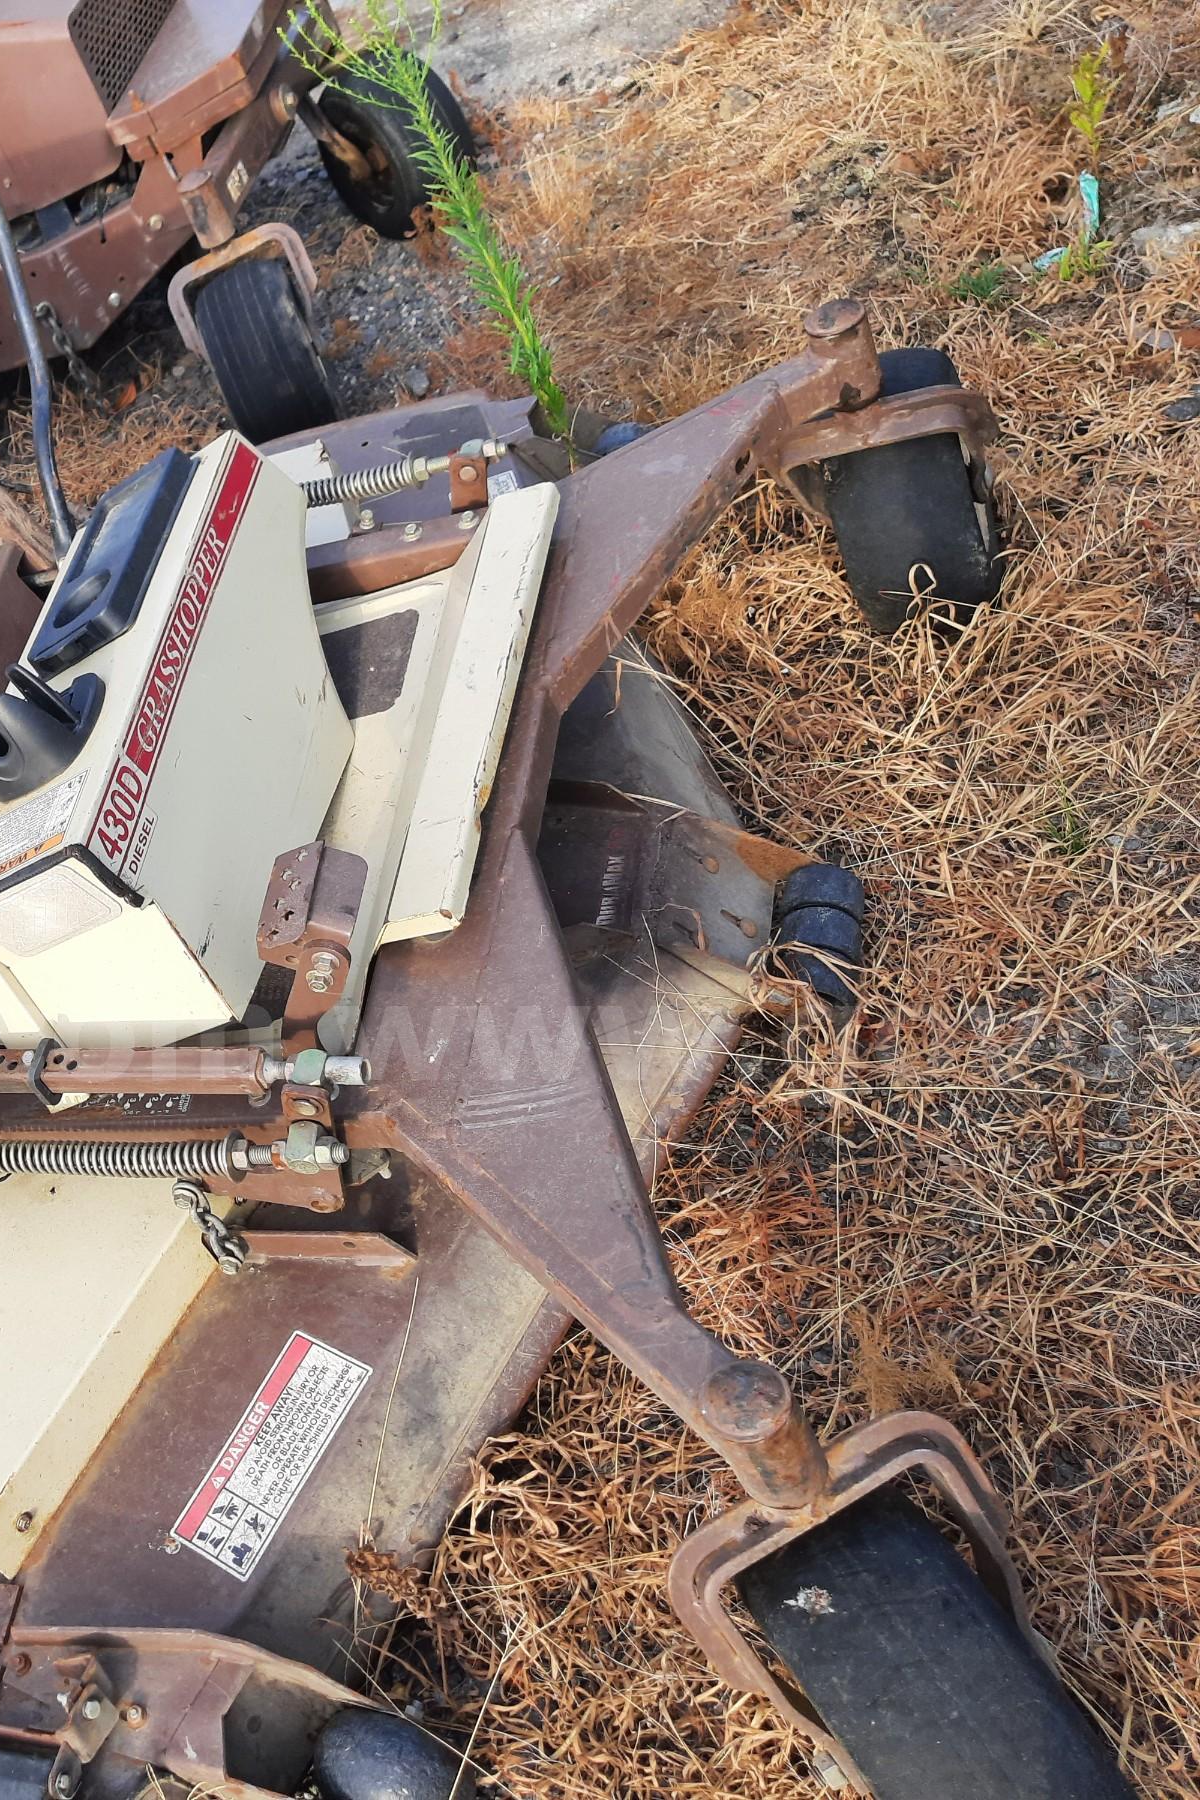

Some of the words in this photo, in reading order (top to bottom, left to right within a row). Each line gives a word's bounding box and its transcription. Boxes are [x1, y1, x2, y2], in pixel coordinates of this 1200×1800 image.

[137, 526, 225, 753] GRASSHOPPER
[98, 765, 144, 860] 430D
[128, 815, 155, 875] DIESEL
[219, 1398, 270, 1472] DANGER
[245, 1465, 256, 1478] TO
[252, 1437, 273, 1466] AVOID
[269, 1404, 293, 1439] SERIOUS
[289, 1377, 310, 1406] INJURY
[306, 1363, 319, 1378] OR
[250, 1458, 271, 1487] DEATH
[266, 1434, 286, 1460] FROM
[281, 1398, 308, 1435] THROWN
[303, 1364, 329, 1400] OBJECTS
[253, 1420, 274, 1447] KEEP
[269, 1385, 295, 1421] AWAY!
[259, 1479, 280, 1508] NEVER
[275, 1442, 302, 1481] OPERATE
[297, 1407, 324, 1445] WITHOUT
[319, 1361, 352, 1409] DISCHARGE
[271, 1455, 284, 1470] OR
[279, 1429, 300, 1457] BLADE
[272, 1476, 293, 1504] CHUTE
[288, 1462, 302, 1477] OR
[296, 1443, 313, 1463] SIDE
[308, 1411, 332, 1445] SHIELDS
[327, 1401, 338, 1413] IN
